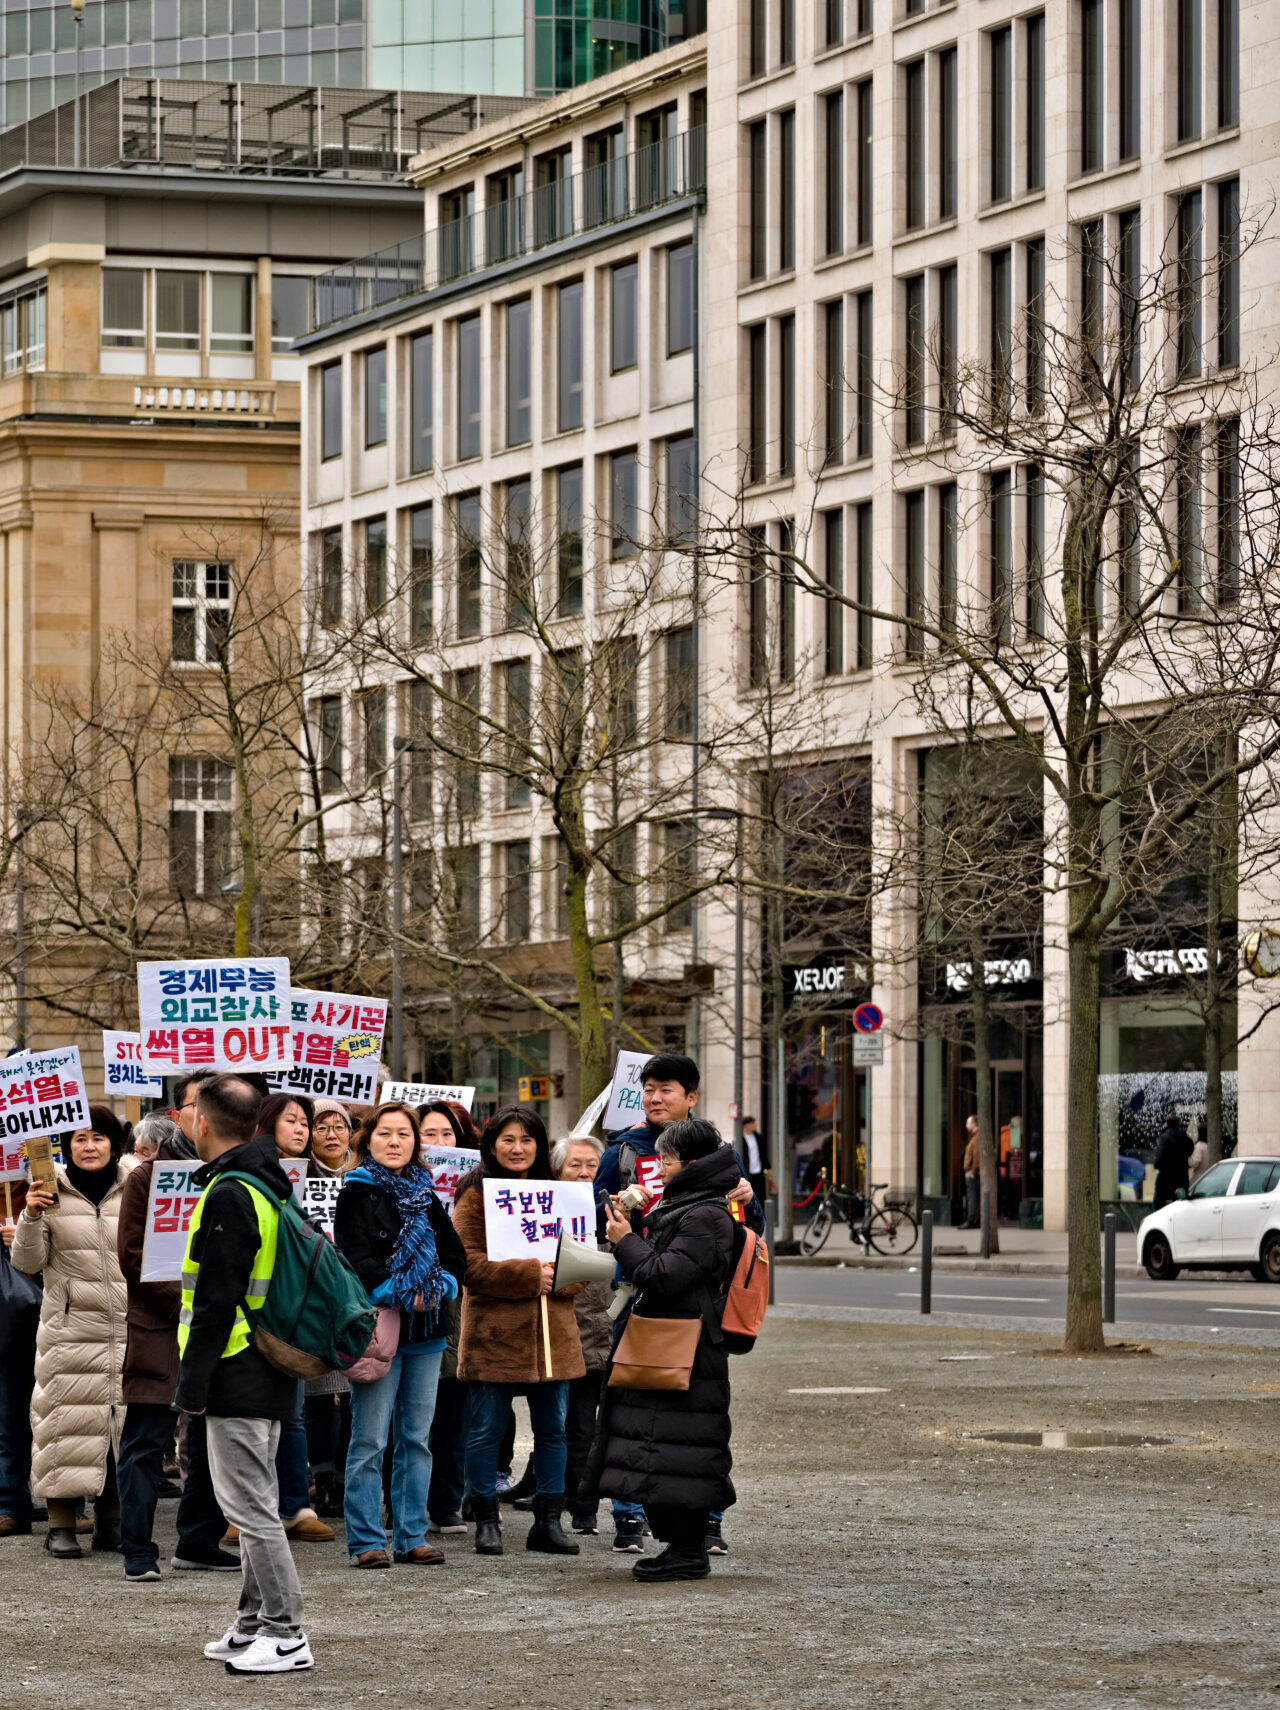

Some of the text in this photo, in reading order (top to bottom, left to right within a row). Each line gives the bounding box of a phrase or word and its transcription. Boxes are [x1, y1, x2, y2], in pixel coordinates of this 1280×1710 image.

[159, 967, 276, 995] 경제무능
[794, 966, 846, 991] XERJOF
[160, 995, 281, 1023] 외교참사
[311, 1001, 385, 1032] 사기꾼
[146, 1025, 290, 1064] 썩열 OUT
[348, 1037, 371, 1052] 탄핵
[26, 1053, 76, 1077] 못살겠다!
[495, 1189, 554, 1215] 국보법
[520, 1217, 562, 1243] 철폐
